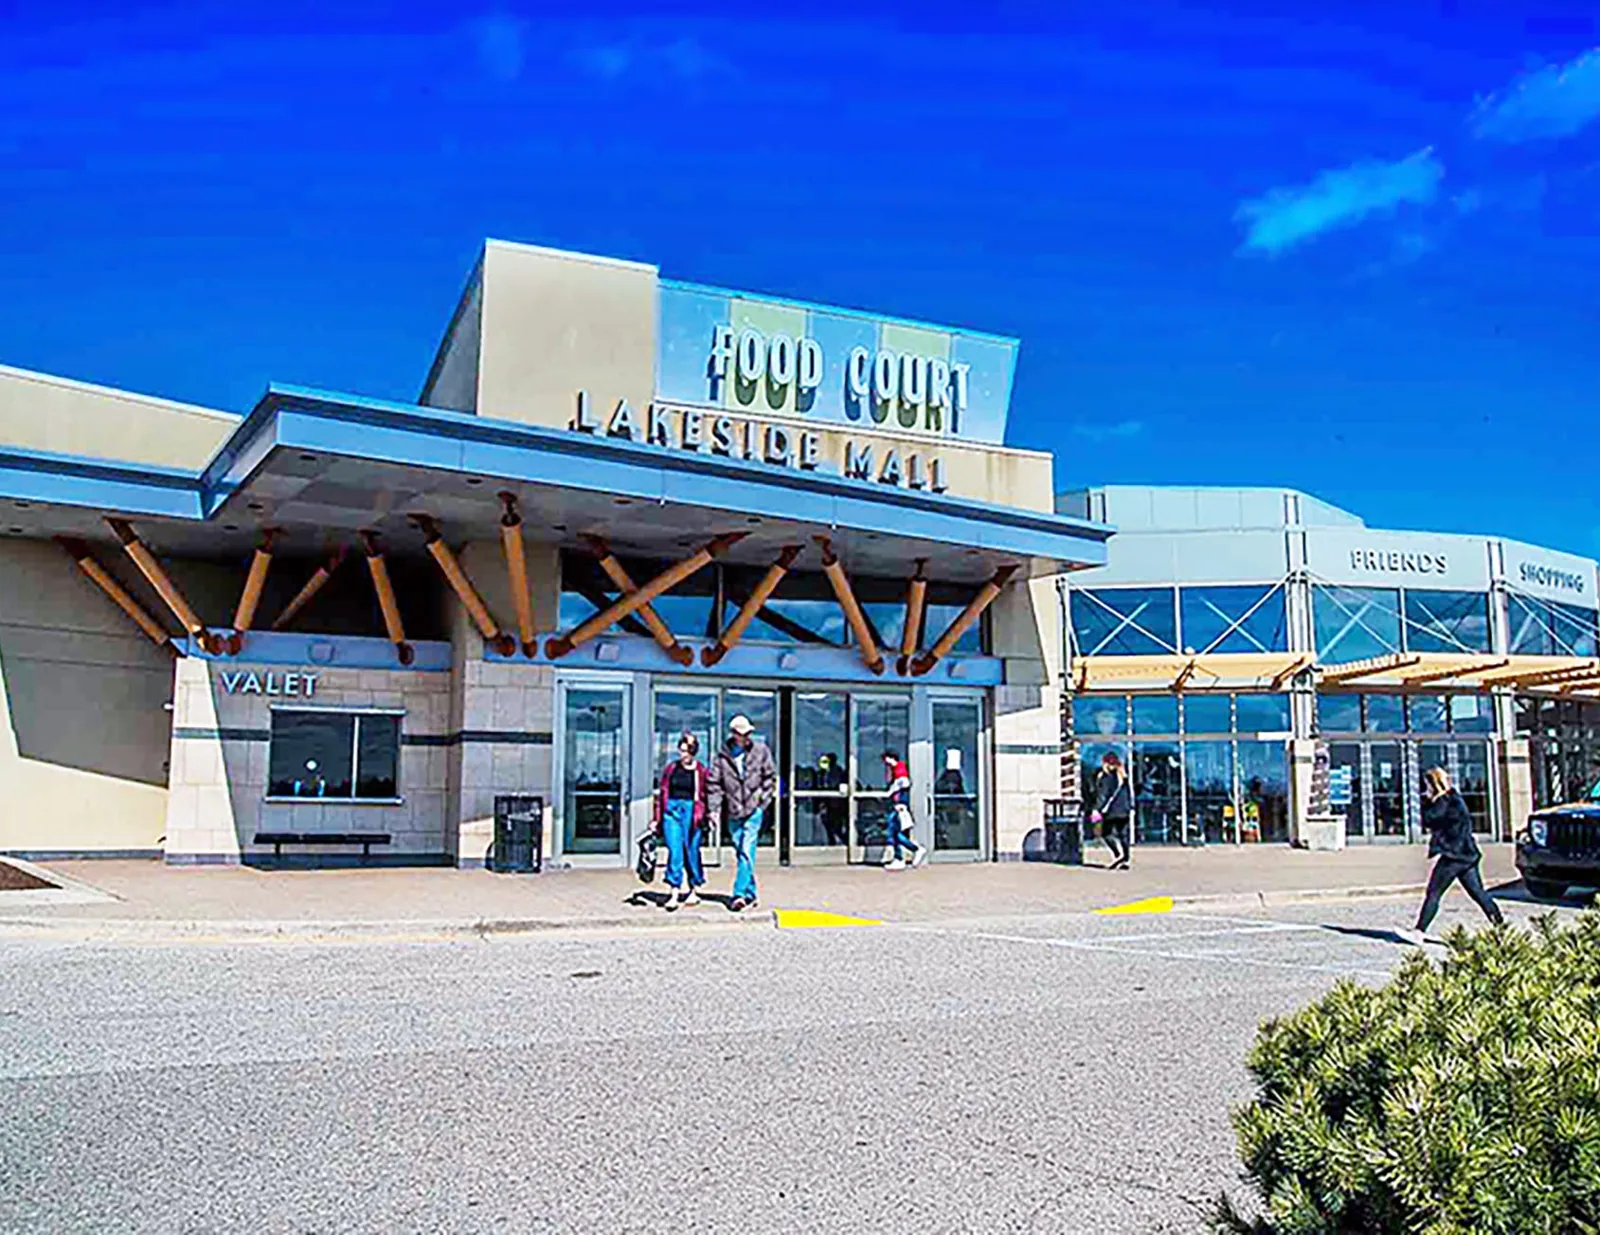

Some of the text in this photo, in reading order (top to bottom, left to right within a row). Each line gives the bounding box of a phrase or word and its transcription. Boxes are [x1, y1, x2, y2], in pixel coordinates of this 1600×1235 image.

[711, 325, 970, 410] FOOD COURT
[574, 388, 949, 493] LAKESIDE MALL
[1350, 549, 1449, 575] FRIENDS
[1519, 562, 1585, 593] SHOPPING
[221, 671, 319, 696] VALET
